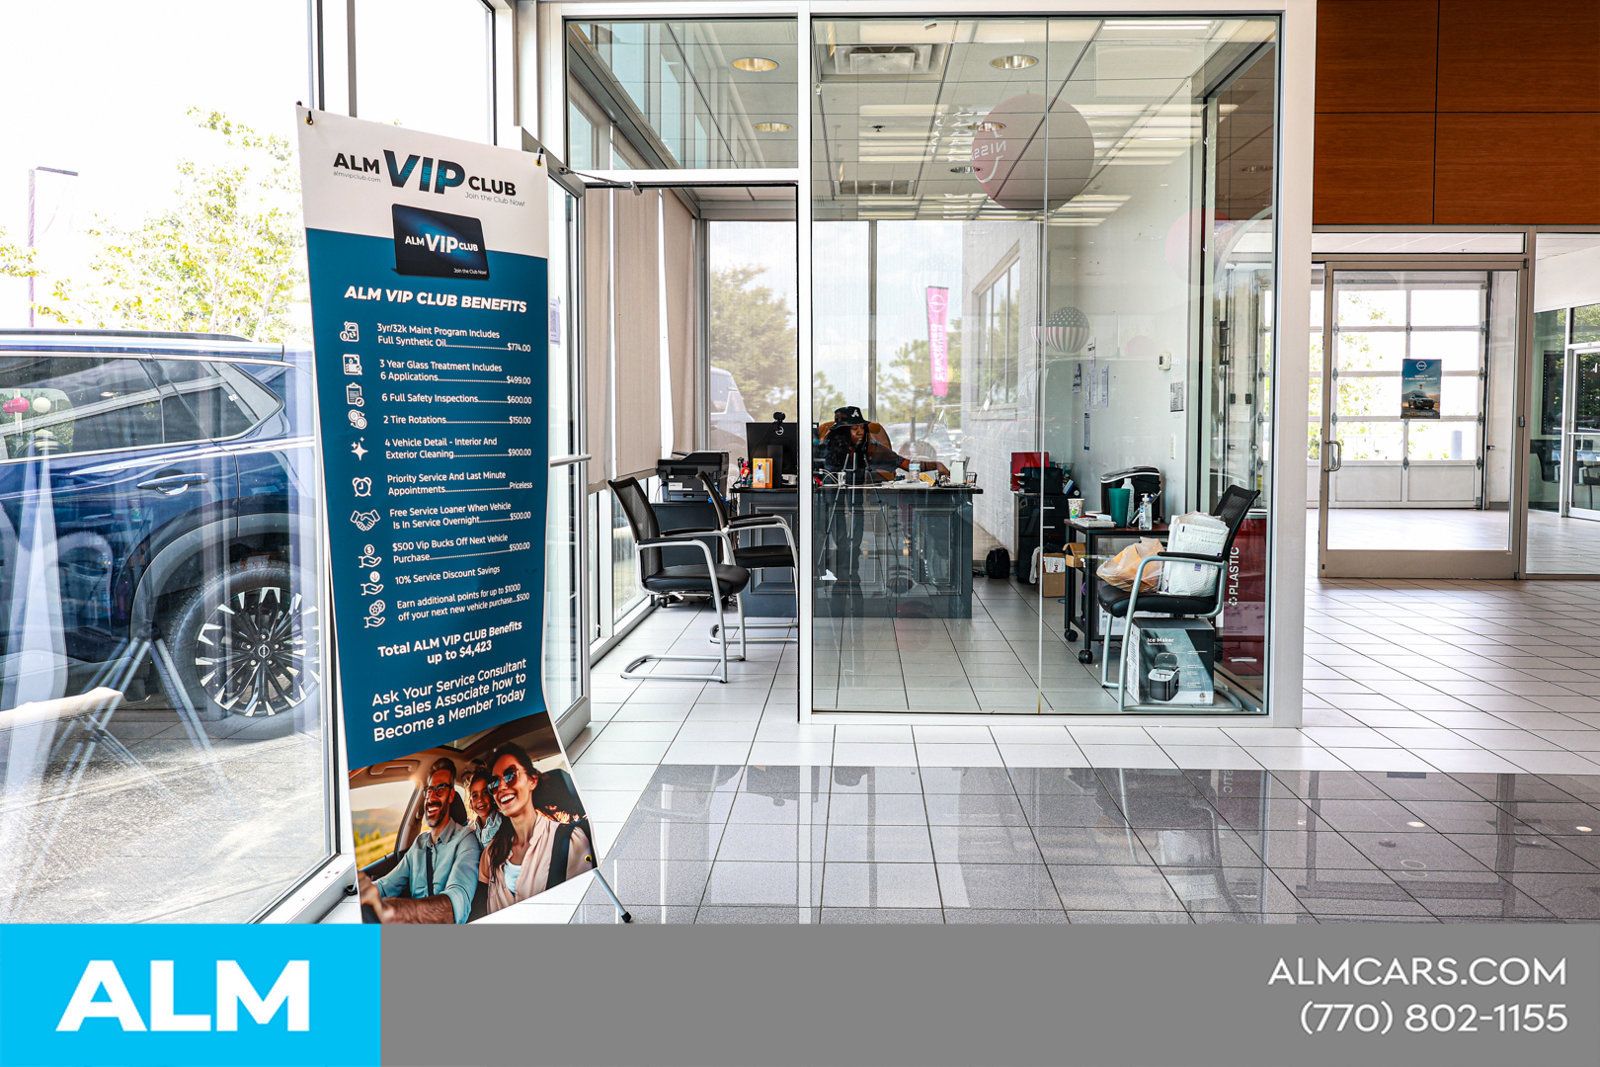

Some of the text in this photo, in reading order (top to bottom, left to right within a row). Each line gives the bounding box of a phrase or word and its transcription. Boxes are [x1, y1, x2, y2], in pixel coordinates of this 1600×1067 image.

[333, 149, 516, 196] ALM VIP CLUB
[494, 196, 508, 204] Club
[405, 233, 478, 253] ALM VIP CLUB
[344, 286, 527, 313] ALM VIP CLUB BENEFITS
[377, 323, 500, 338] 3yr/32k Maint Program Includes
[378, 336, 394, 344] Full
[396, 336, 433, 346] Synthetic
[380, 359, 502, 372] 3 Year Glass Treatment Includes
[381, 372, 386, 380] 6
[382, 393, 387, 402] 6
[390, 393, 405, 402] Full
[407, 394, 433, 403] Safety
[384, 416, 389, 424] 2
[391, 415, 406, 424] Tire
[385, 439, 390, 447] 4
[392, 438, 422, 447] Vehicle
[424, 438, 447, 446] Detail
[455, 437, 481, 445] Interior
[483, 437, 497, 445] And
[386, 450, 417, 459] Exterior
[387, 474, 417, 483] Priority
[419, 473, 447, 482] Service
[449, 472, 465, 480] And
[483, 471, 506, 479] Minute
[390, 502, 511, 517] Free Service Loaner When Vehicle
[393, 521, 400, 529] Is
[412, 519, 441, 528] Service
[392, 542, 414, 552] $500
[416, 541, 430, 550] Vip
[431, 539, 454, 548] Bucks
[456, 537, 468, 546] Off
[487, 534, 508, 543] Vehicle
[395, 566, 500, 584] 10% Service Discount Savings
[1228, 546, 1241, 596] PLASTIC
[397, 600, 415, 609] Earn
[418, 594, 455, 606] additional
[457, 592, 479, 602] points
[398, 612, 409, 621] off
[412, 611, 429, 621] your
[431, 607, 448, 616] next
[450, 606, 465, 614] new
[467, 601, 487, 611] vehicle
[378, 621, 522, 657] Total ALM VIP CLUB Benefits
[427, 639, 492, 665] up to $4,423
[372, 658, 527, 707] Ask Your Service Consultant
[373, 673, 526, 723] or Sales Associate how to
[373, 689, 526, 742] Become a Member Today
